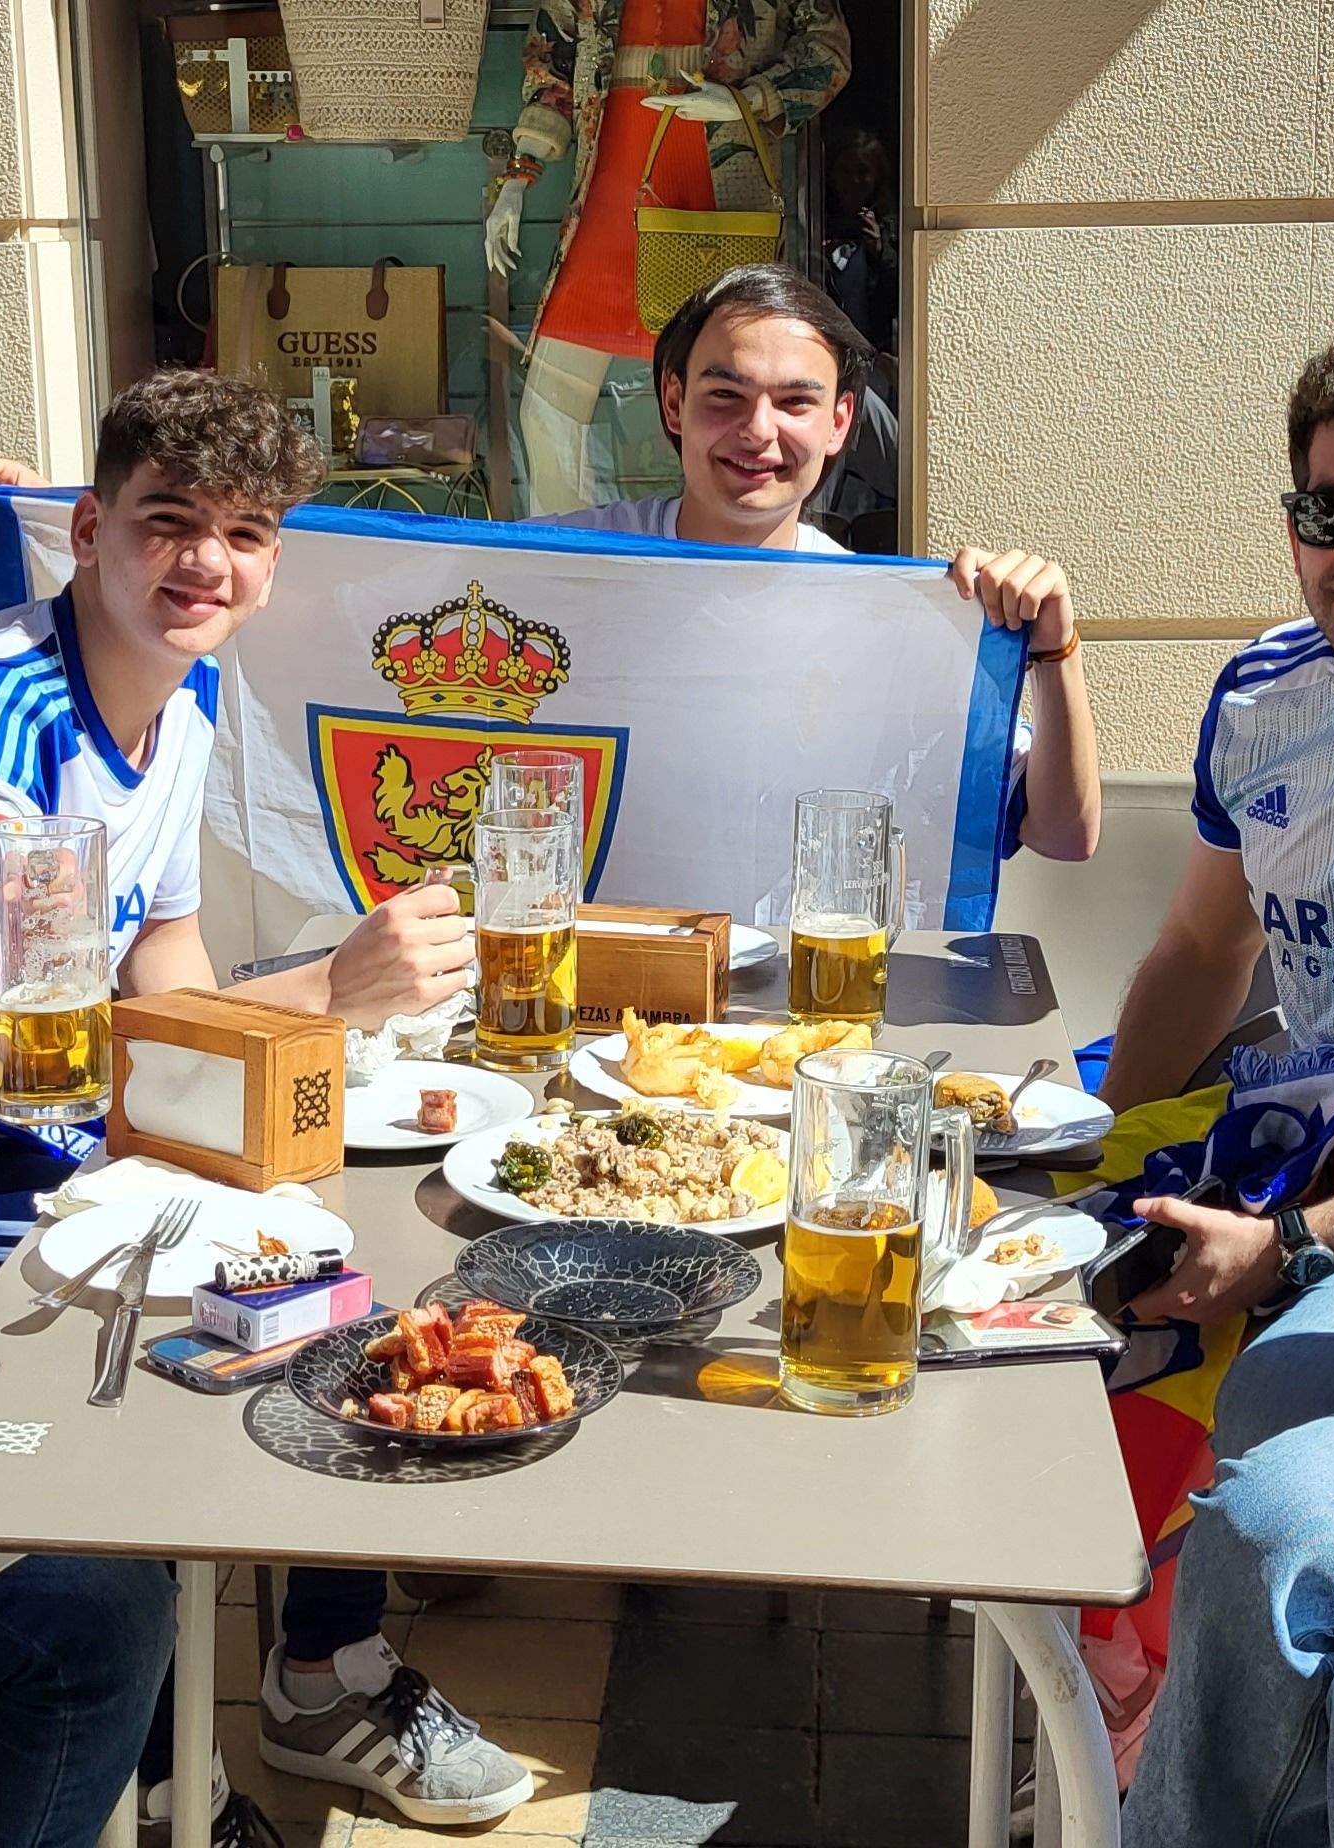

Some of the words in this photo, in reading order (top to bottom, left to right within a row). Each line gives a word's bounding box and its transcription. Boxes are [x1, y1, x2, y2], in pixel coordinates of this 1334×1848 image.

[277, 331, 378, 355] GUESS
[292, 356, 323, 368] EST
[326, 356, 363, 368] 1981
[1246, 805, 1290, 830] adidas
[576, 1006, 610, 1023] EZAS
